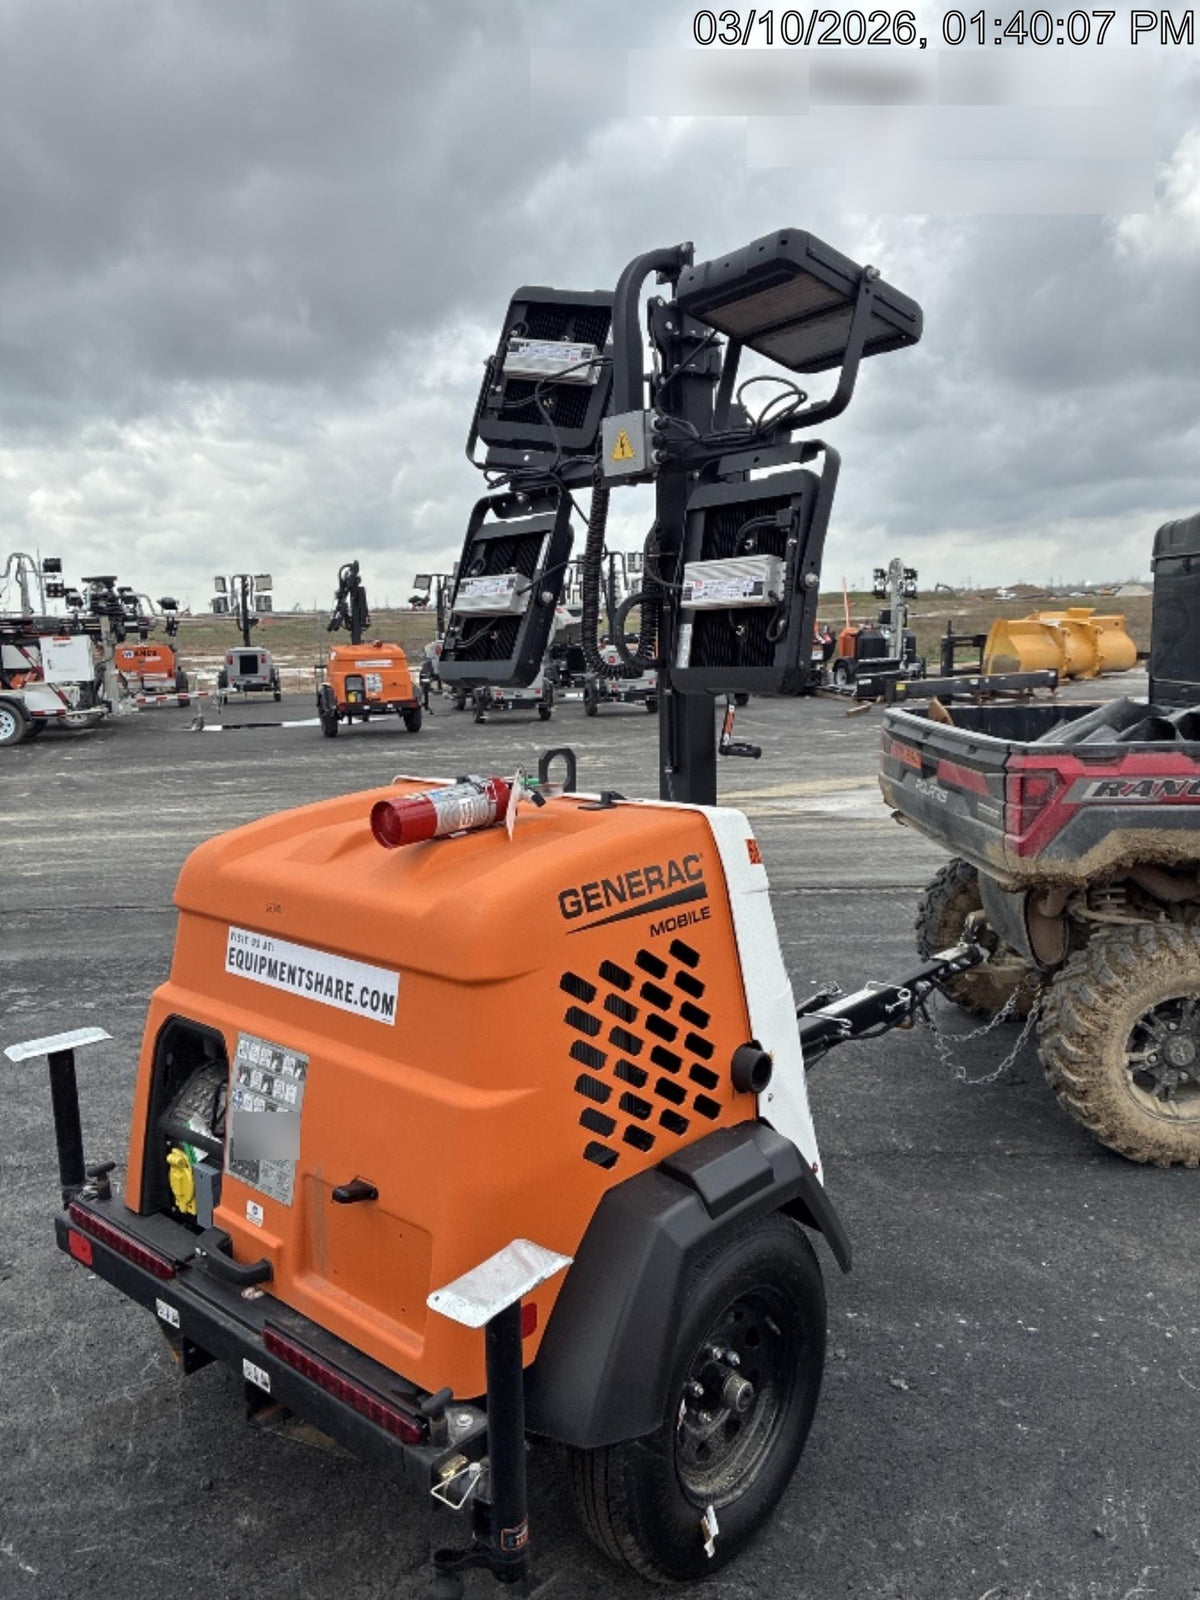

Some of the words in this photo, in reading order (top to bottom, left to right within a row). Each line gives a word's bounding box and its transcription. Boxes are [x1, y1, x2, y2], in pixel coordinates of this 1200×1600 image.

[558, 854, 703, 919] GENERAC
[649, 906, 712, 938] MOBILE
[228, 946, 396, 1016] EQUIPMENTSHARE.COM
